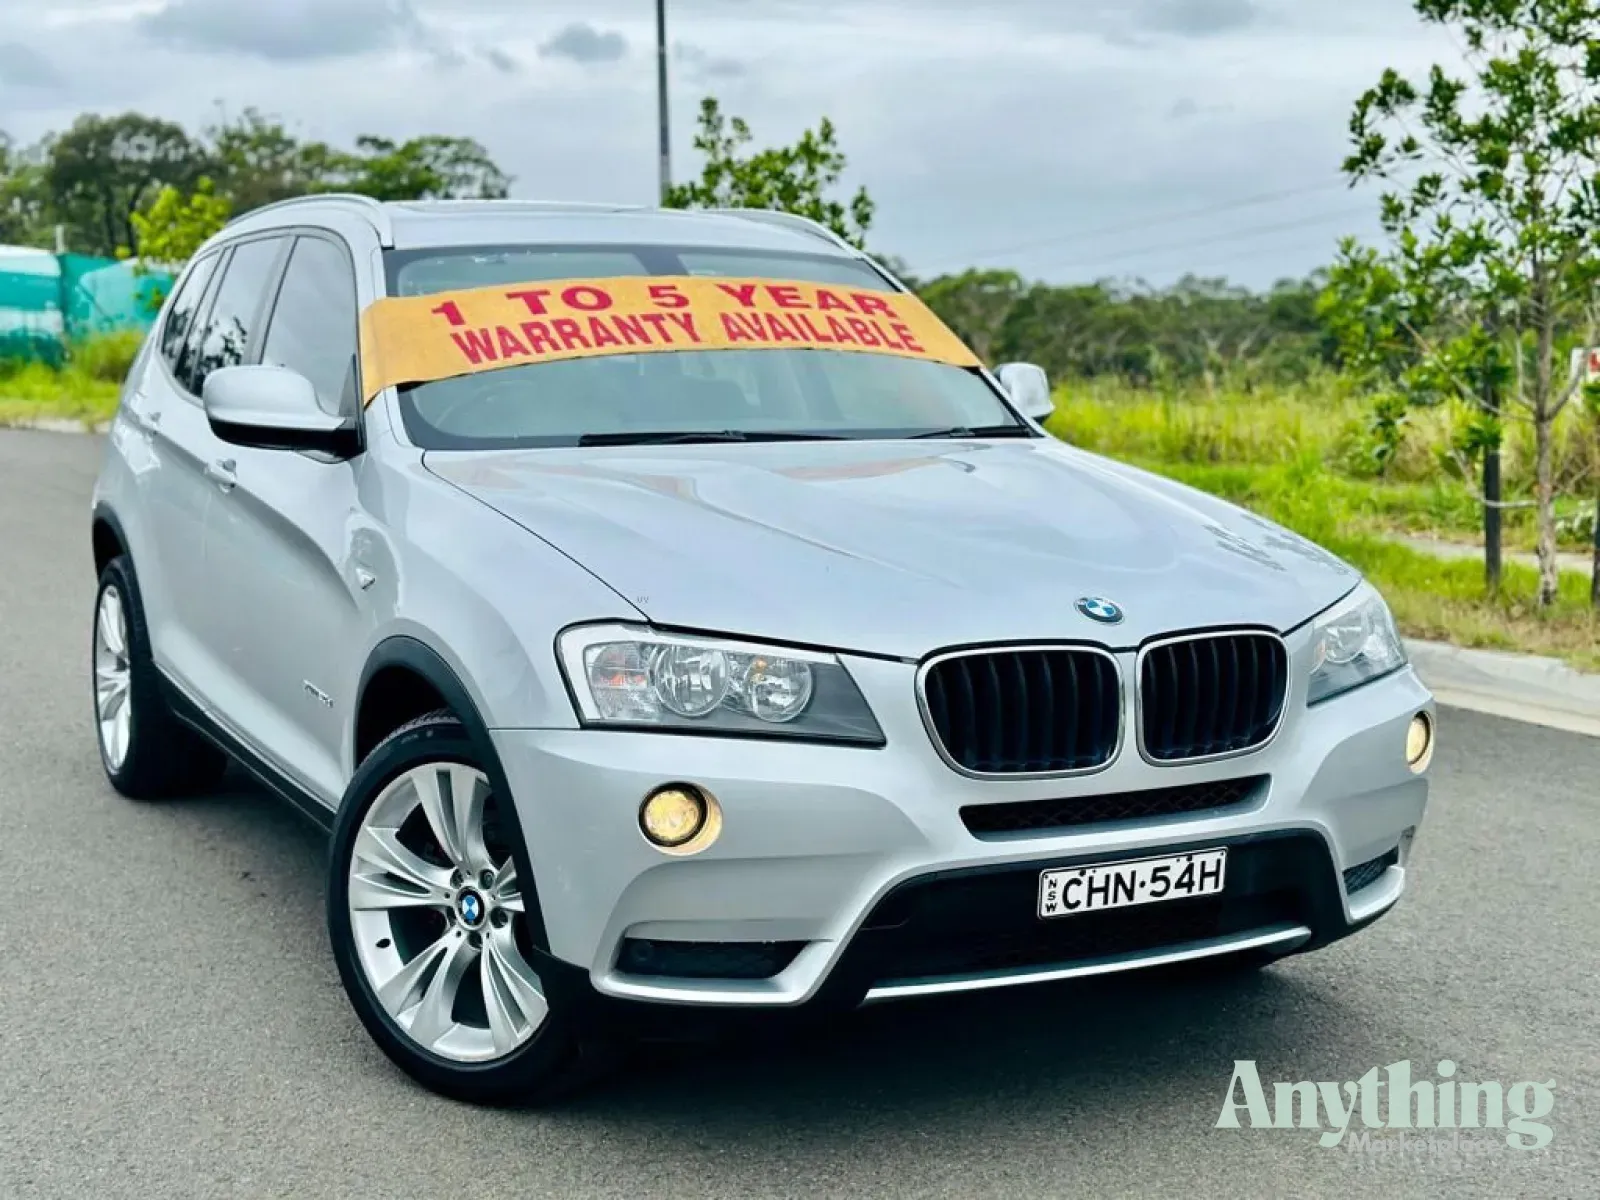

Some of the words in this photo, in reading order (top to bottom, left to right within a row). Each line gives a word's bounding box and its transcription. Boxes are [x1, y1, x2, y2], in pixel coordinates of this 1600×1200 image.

[431, 301, 467, 326] 1
[506, 285, 613, 316] TO
[648, 285, 690, 309] 5
[717, 283, 898, 319] YEAR
[450, 312, 701, 366] WARRANTY
[719, 312, 926, 353] AVAILABLE
